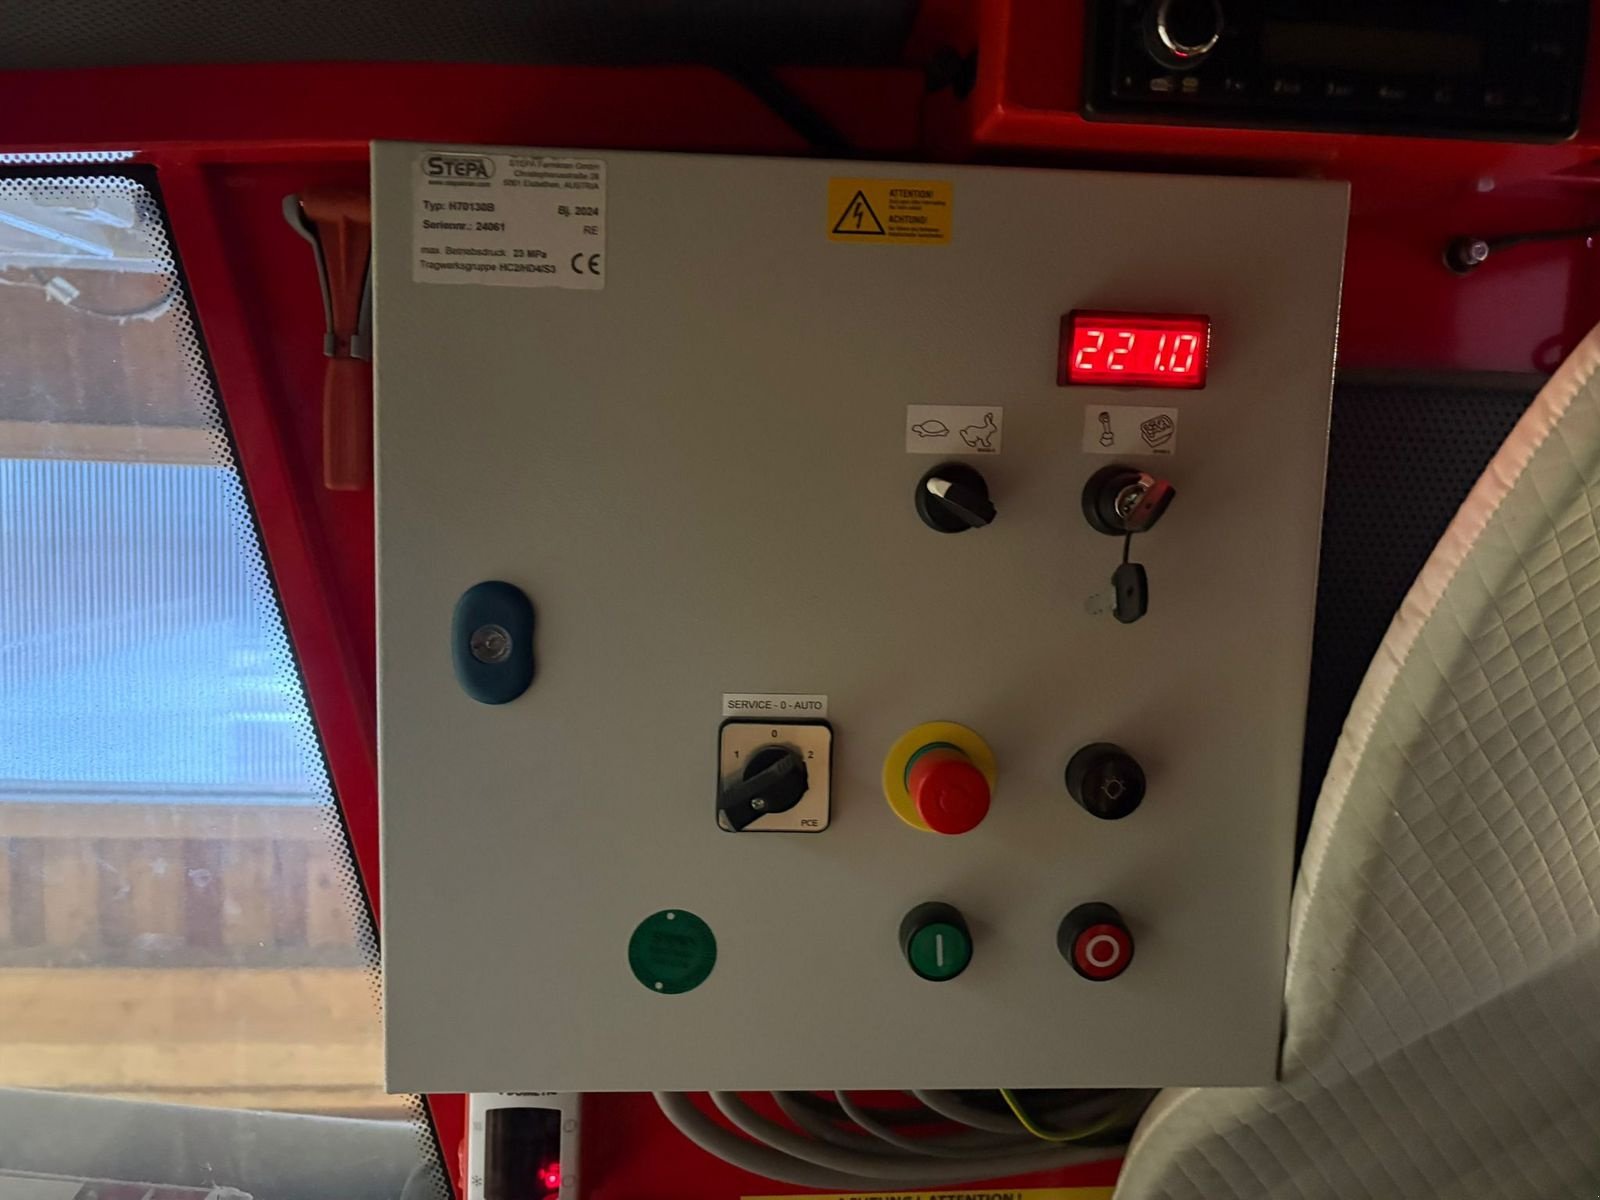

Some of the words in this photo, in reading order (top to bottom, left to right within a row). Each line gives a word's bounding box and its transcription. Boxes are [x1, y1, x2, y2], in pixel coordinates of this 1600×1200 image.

[427, 156, 489, 178] STEPA
[422, 200, 446, 212] Typ:
[575, 206, 599, 216] 2024
[475, 221, 505, 232] 24061
[1074, 330, 1199, 373] 221.0
[727, 700, 773, 710] SERVICE
[794, 700, 823, 710] AUTO
[770, 729, 778, 738] 0
[734, 750, 739, 759] 1
[808, 750, 814, 759] 2
[801, 819, 819, 827] PCE
